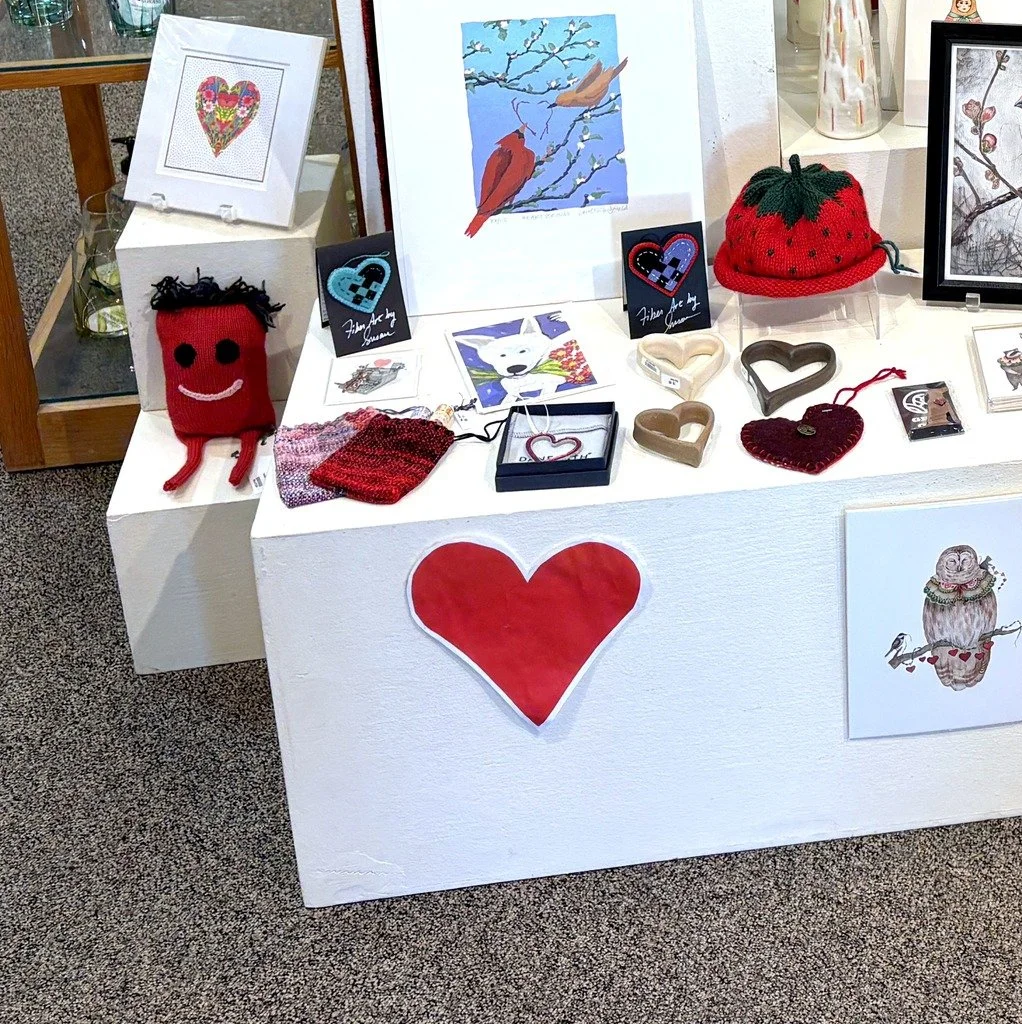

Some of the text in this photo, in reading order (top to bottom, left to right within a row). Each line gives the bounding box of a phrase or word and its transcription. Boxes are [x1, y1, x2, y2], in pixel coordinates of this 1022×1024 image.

[385, 307, 397, 328] by
[636, 306, 663, 326] Fiber
[687, 292, 700, 311] by
